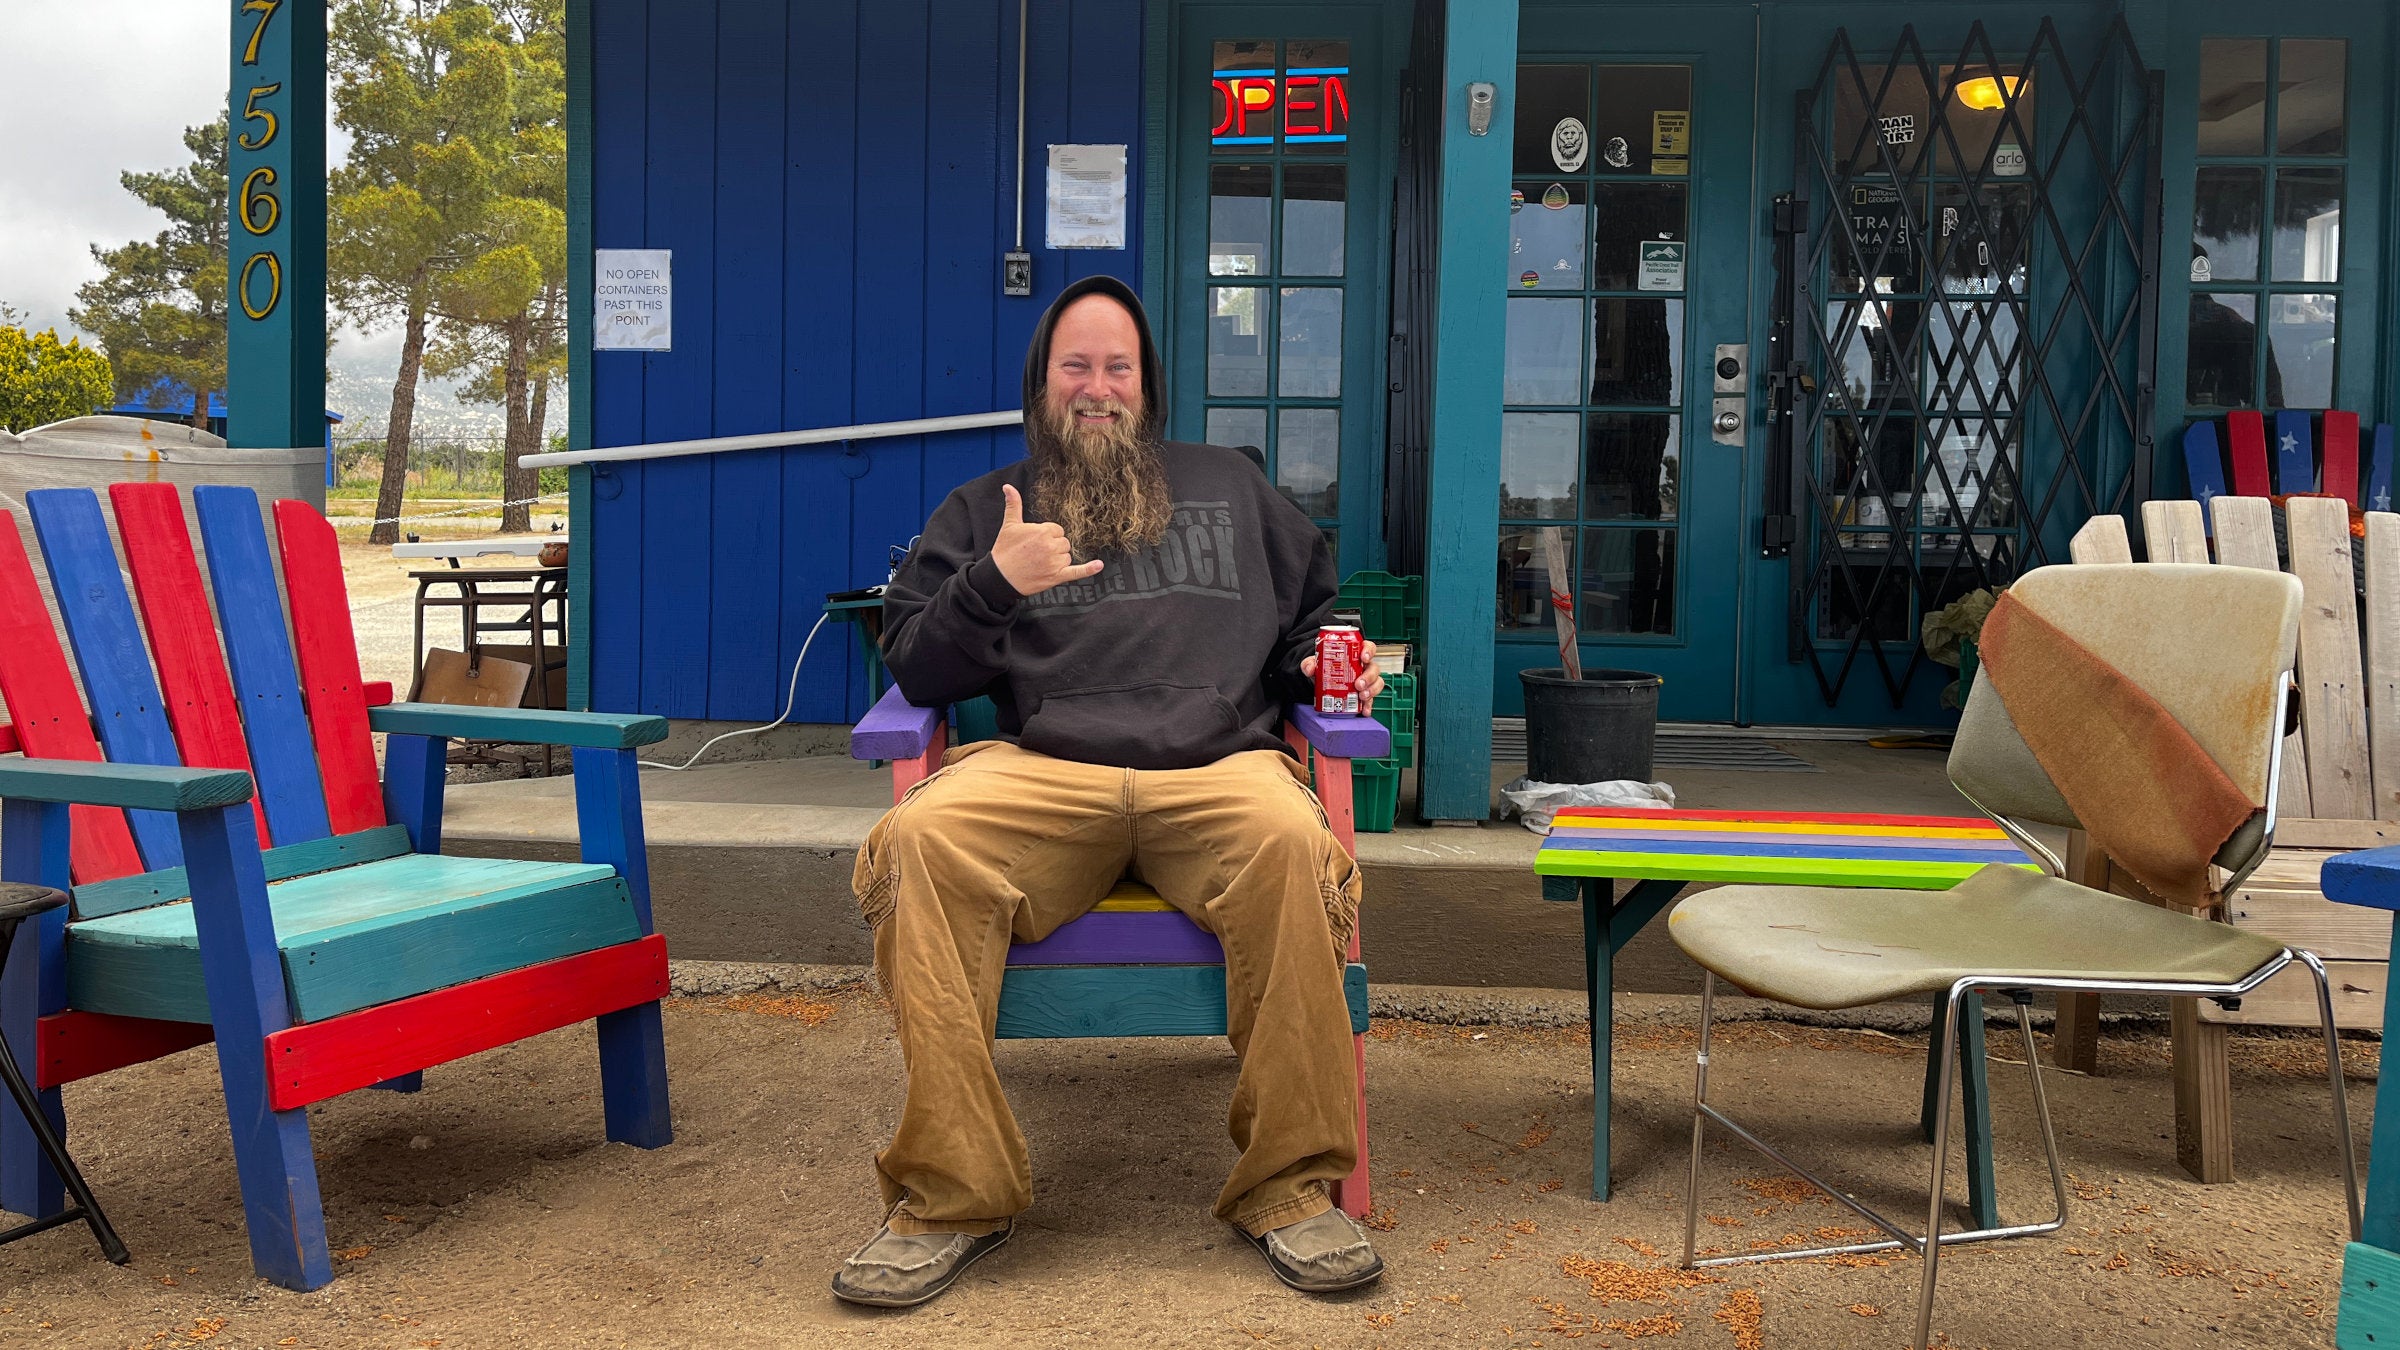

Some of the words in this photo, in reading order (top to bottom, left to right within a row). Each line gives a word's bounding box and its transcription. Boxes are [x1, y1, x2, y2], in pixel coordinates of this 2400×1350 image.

[1880, 116, 1912, 129] MAN
[238, 0, 283, 321] 7560
[1996, 151, 2024, 165] arlo
[1853, 216, 1906, 229] TRAL
[1855, 231, 1905, 244] MAS
[606, 269, 624, 280] NO
[626, 269, 659, 280] OPEN
[598, 285, 668, 295] CONTAINERS
[604, 300, 633, 310] PAST
[636, 300, 663, 310] THIS
[615, 315, 651, 326] POINT
[1131, 525, 1240, 591] ROCK
